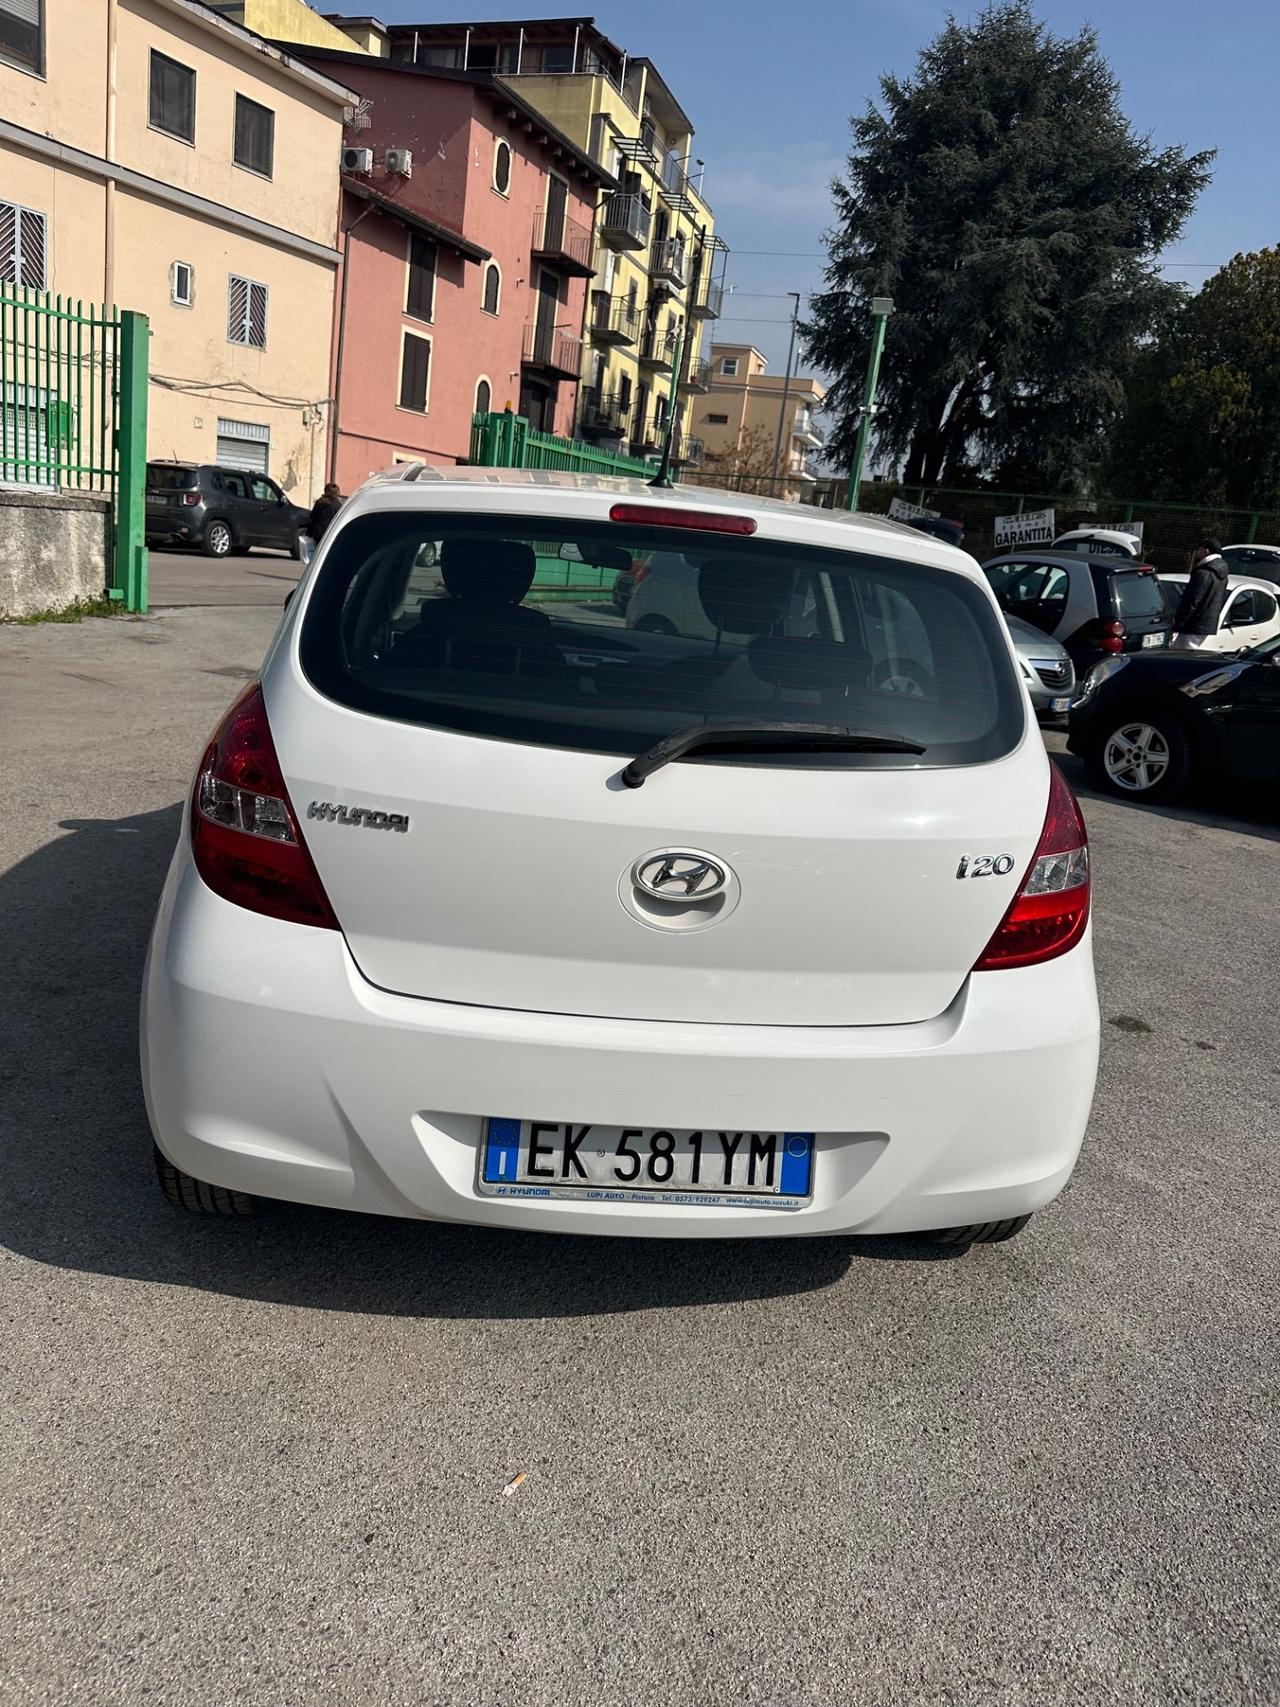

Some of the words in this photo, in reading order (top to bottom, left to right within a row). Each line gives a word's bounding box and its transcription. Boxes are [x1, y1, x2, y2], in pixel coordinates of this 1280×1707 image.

[995, 526, 1053, 546] GARANTITA
[308, 800, 410, 834] HYUNDAI
[956, 853, 1015, 880] i20
[527, 1124, 592, 1178] EK
[614, 1130, 777, 1186] 581YM
[510, 1187, 551, 1196] HYUNDAI
[604, 1192, 625, 1200] AUTO
